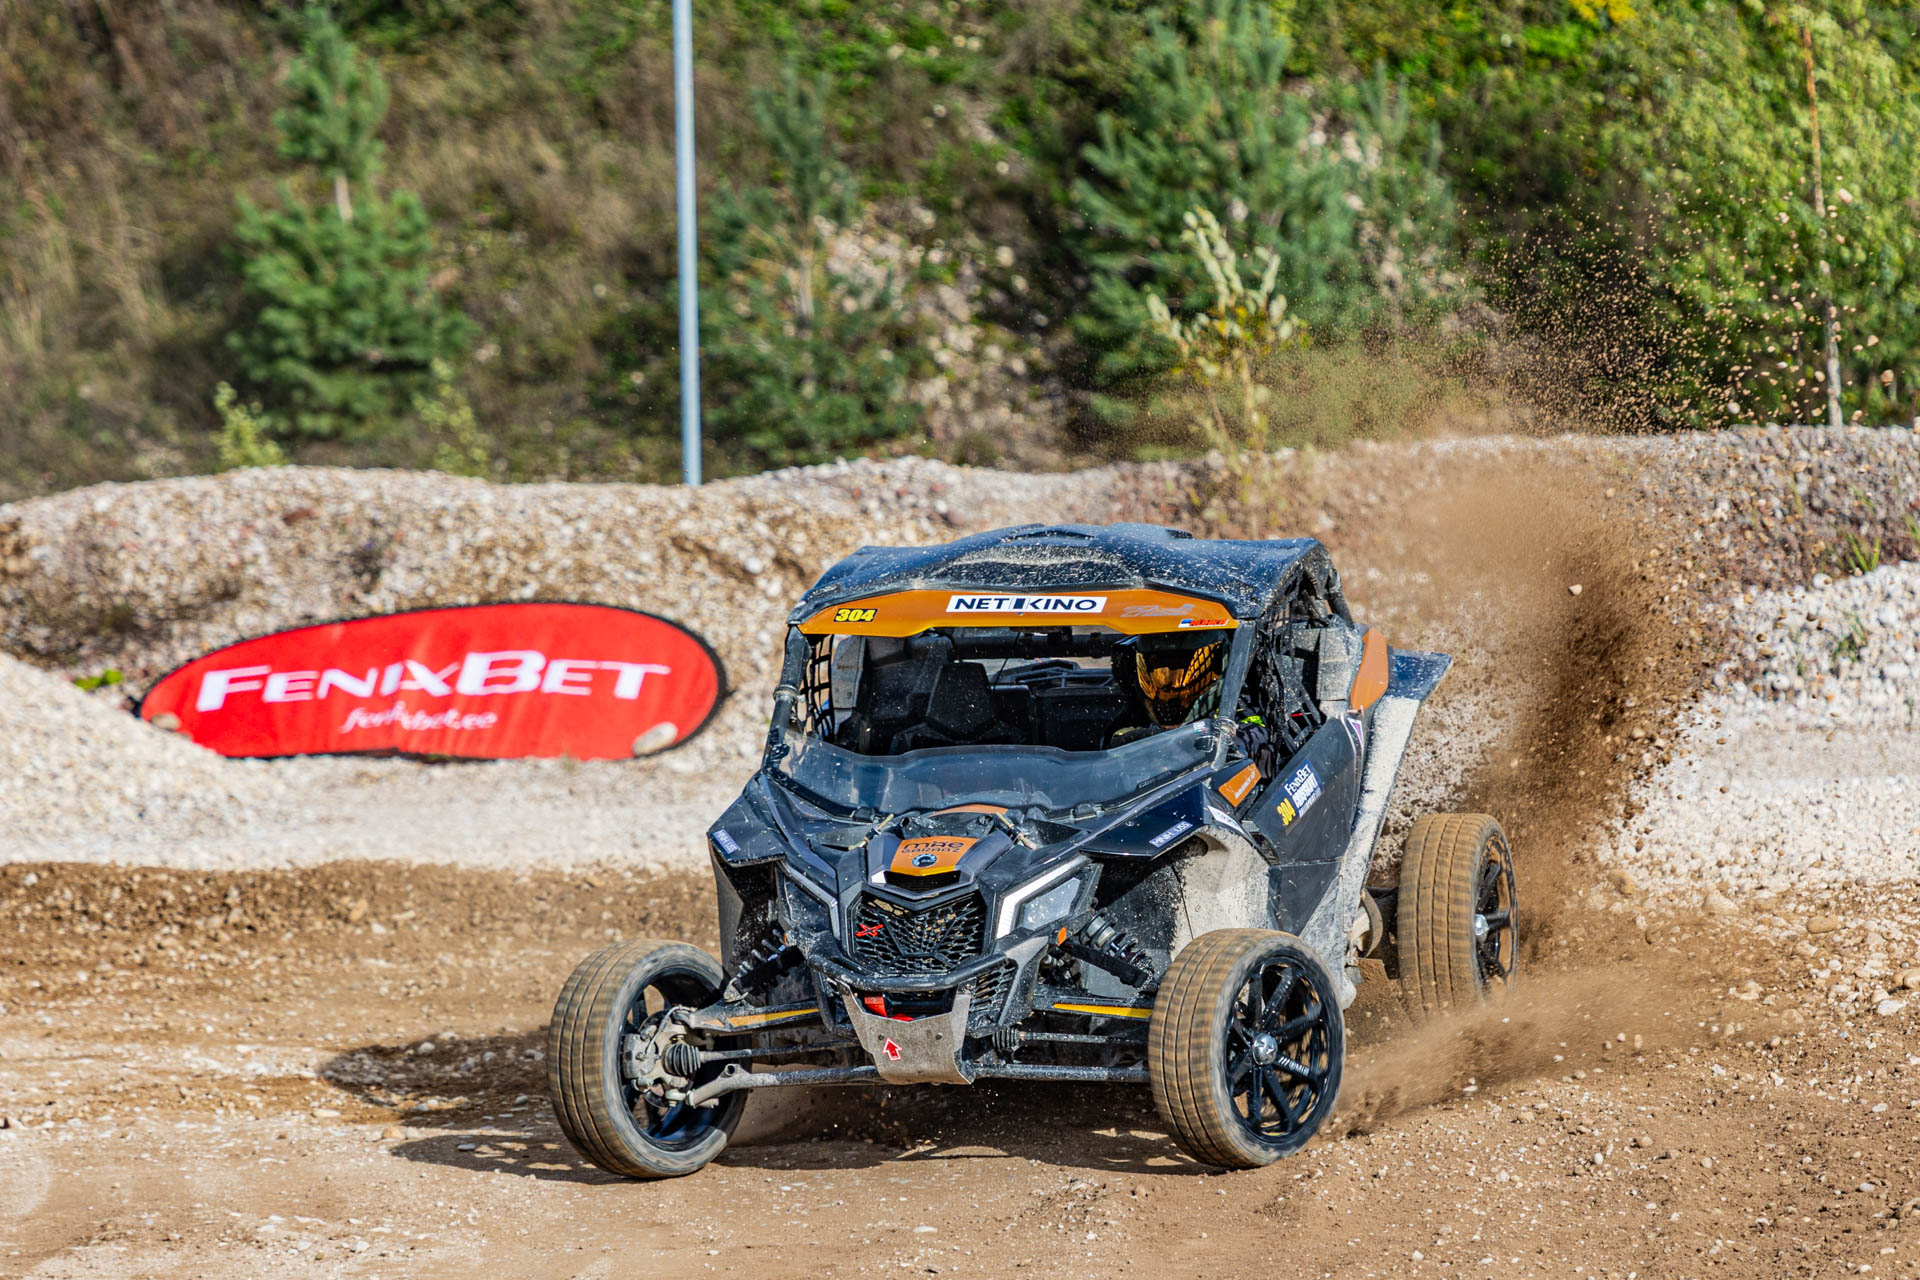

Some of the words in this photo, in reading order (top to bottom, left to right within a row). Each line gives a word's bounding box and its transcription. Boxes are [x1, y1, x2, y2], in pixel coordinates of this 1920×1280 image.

[835, 609, 876, 621] 304
[196, 650, 672, 712] FENIXBET
[1277, 798, 1296, 826] 304
